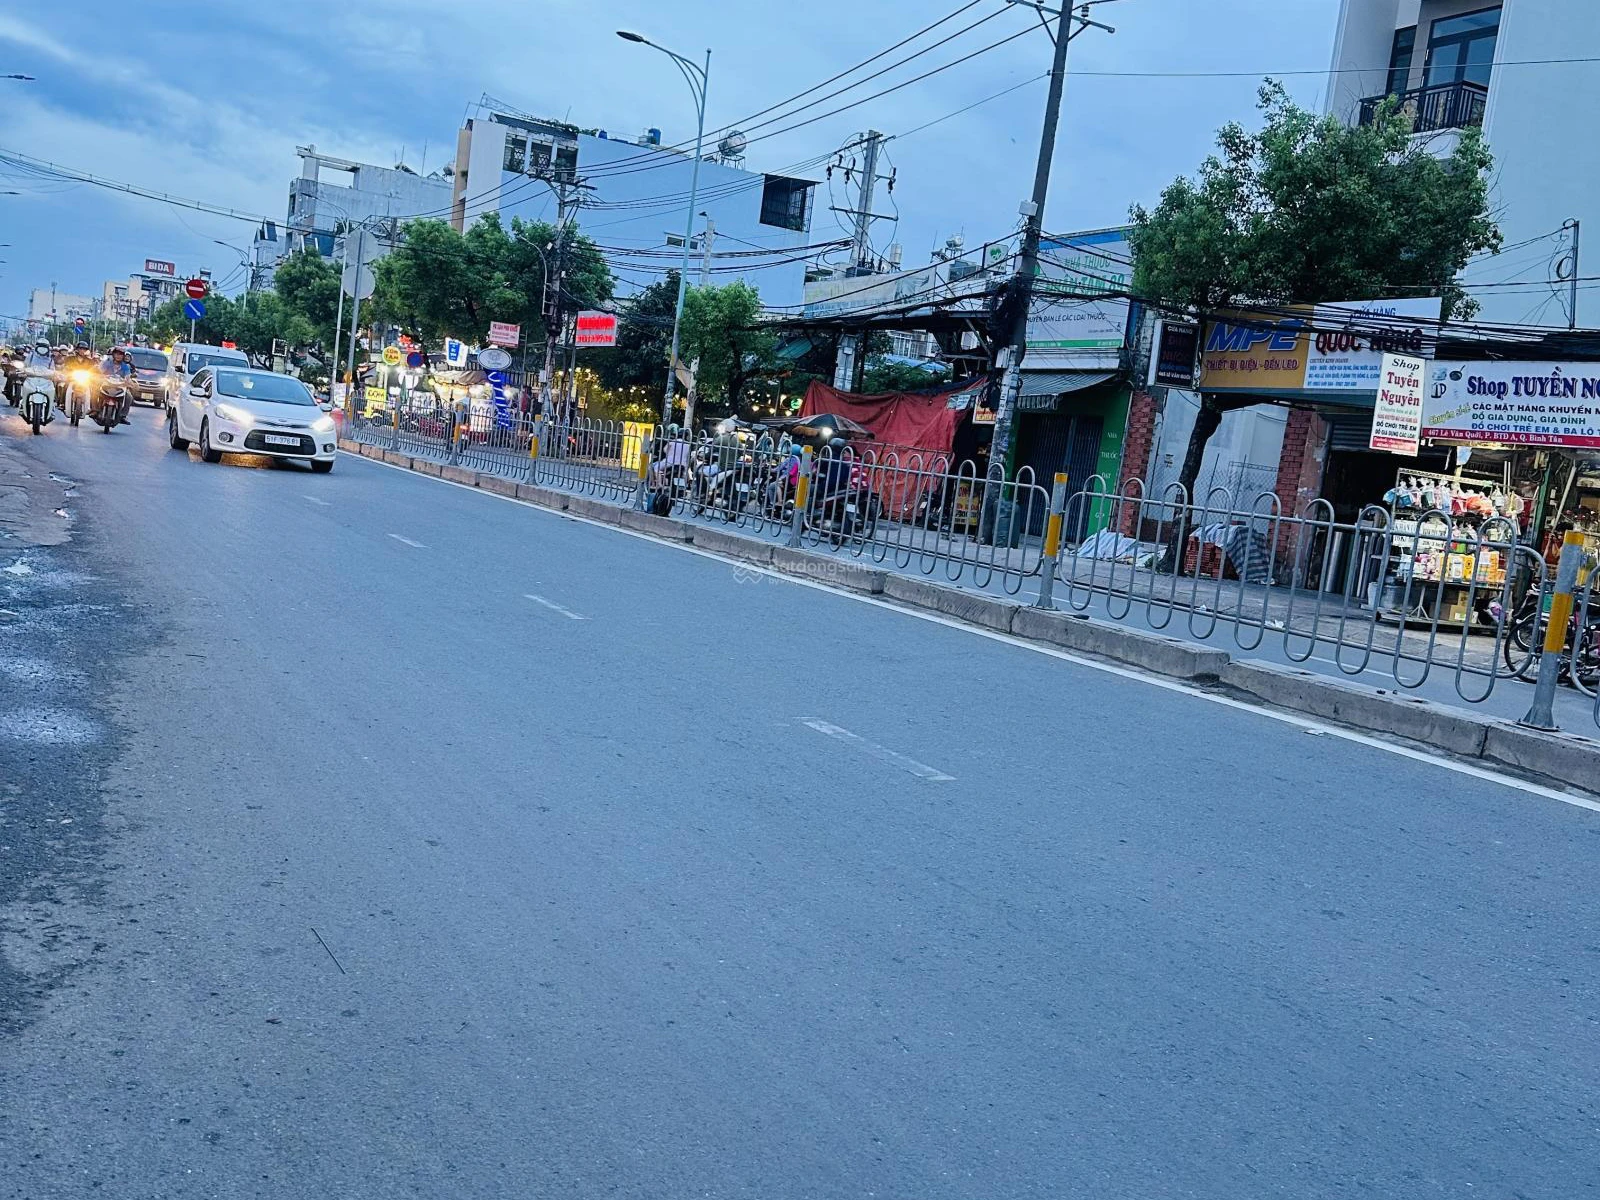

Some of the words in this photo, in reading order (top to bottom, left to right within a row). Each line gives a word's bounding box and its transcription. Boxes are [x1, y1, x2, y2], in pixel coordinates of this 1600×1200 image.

[148, 261, 170, 272] BIDA
[1205, 319, 1307, 352] MPE
[1391, 358, 1420, 371] Shop
[1467, 376, 1508, 400] Shop
[1512, 366, 1577, 399] TUYỀN
[1380, 389, 1420, 406] Nguyễn
[1472, 403, 1492, 411] CÁC
[1494, 403, 1514, 413] MẶT
[1517, 403, 1545, 413] HÀNG
[1548, 404, 1592, 415] KHUYẾN
[1472, 412, 1485, 420] ĐỒ
[1488, 413, 1504, 421] GIA
[1507, 414, 1537, 423] DỤNG,
[1540, 415, 1558, 423] GIA
[1560, 414, 1586, 425] ĐÌNH
[1472, 422, 1485, 430] ĐỒ
[1487, 422, 1510, 431] CHƠI
[1513, 423, 1533, 433] TRẺ
[1535, 425, 1550, 433] EM
[1553, 426, 1560, 434] &
[1563, 427, 1577, 435] BA
[1440, 429, 1449, 437] Lê
[1485, 431, 1492, 439] P.
[1494, 432, 1509, 440] BTĐ
[1520, 434, 1528, 442] Q.
[1548, 435, 1563, 443] Tân
